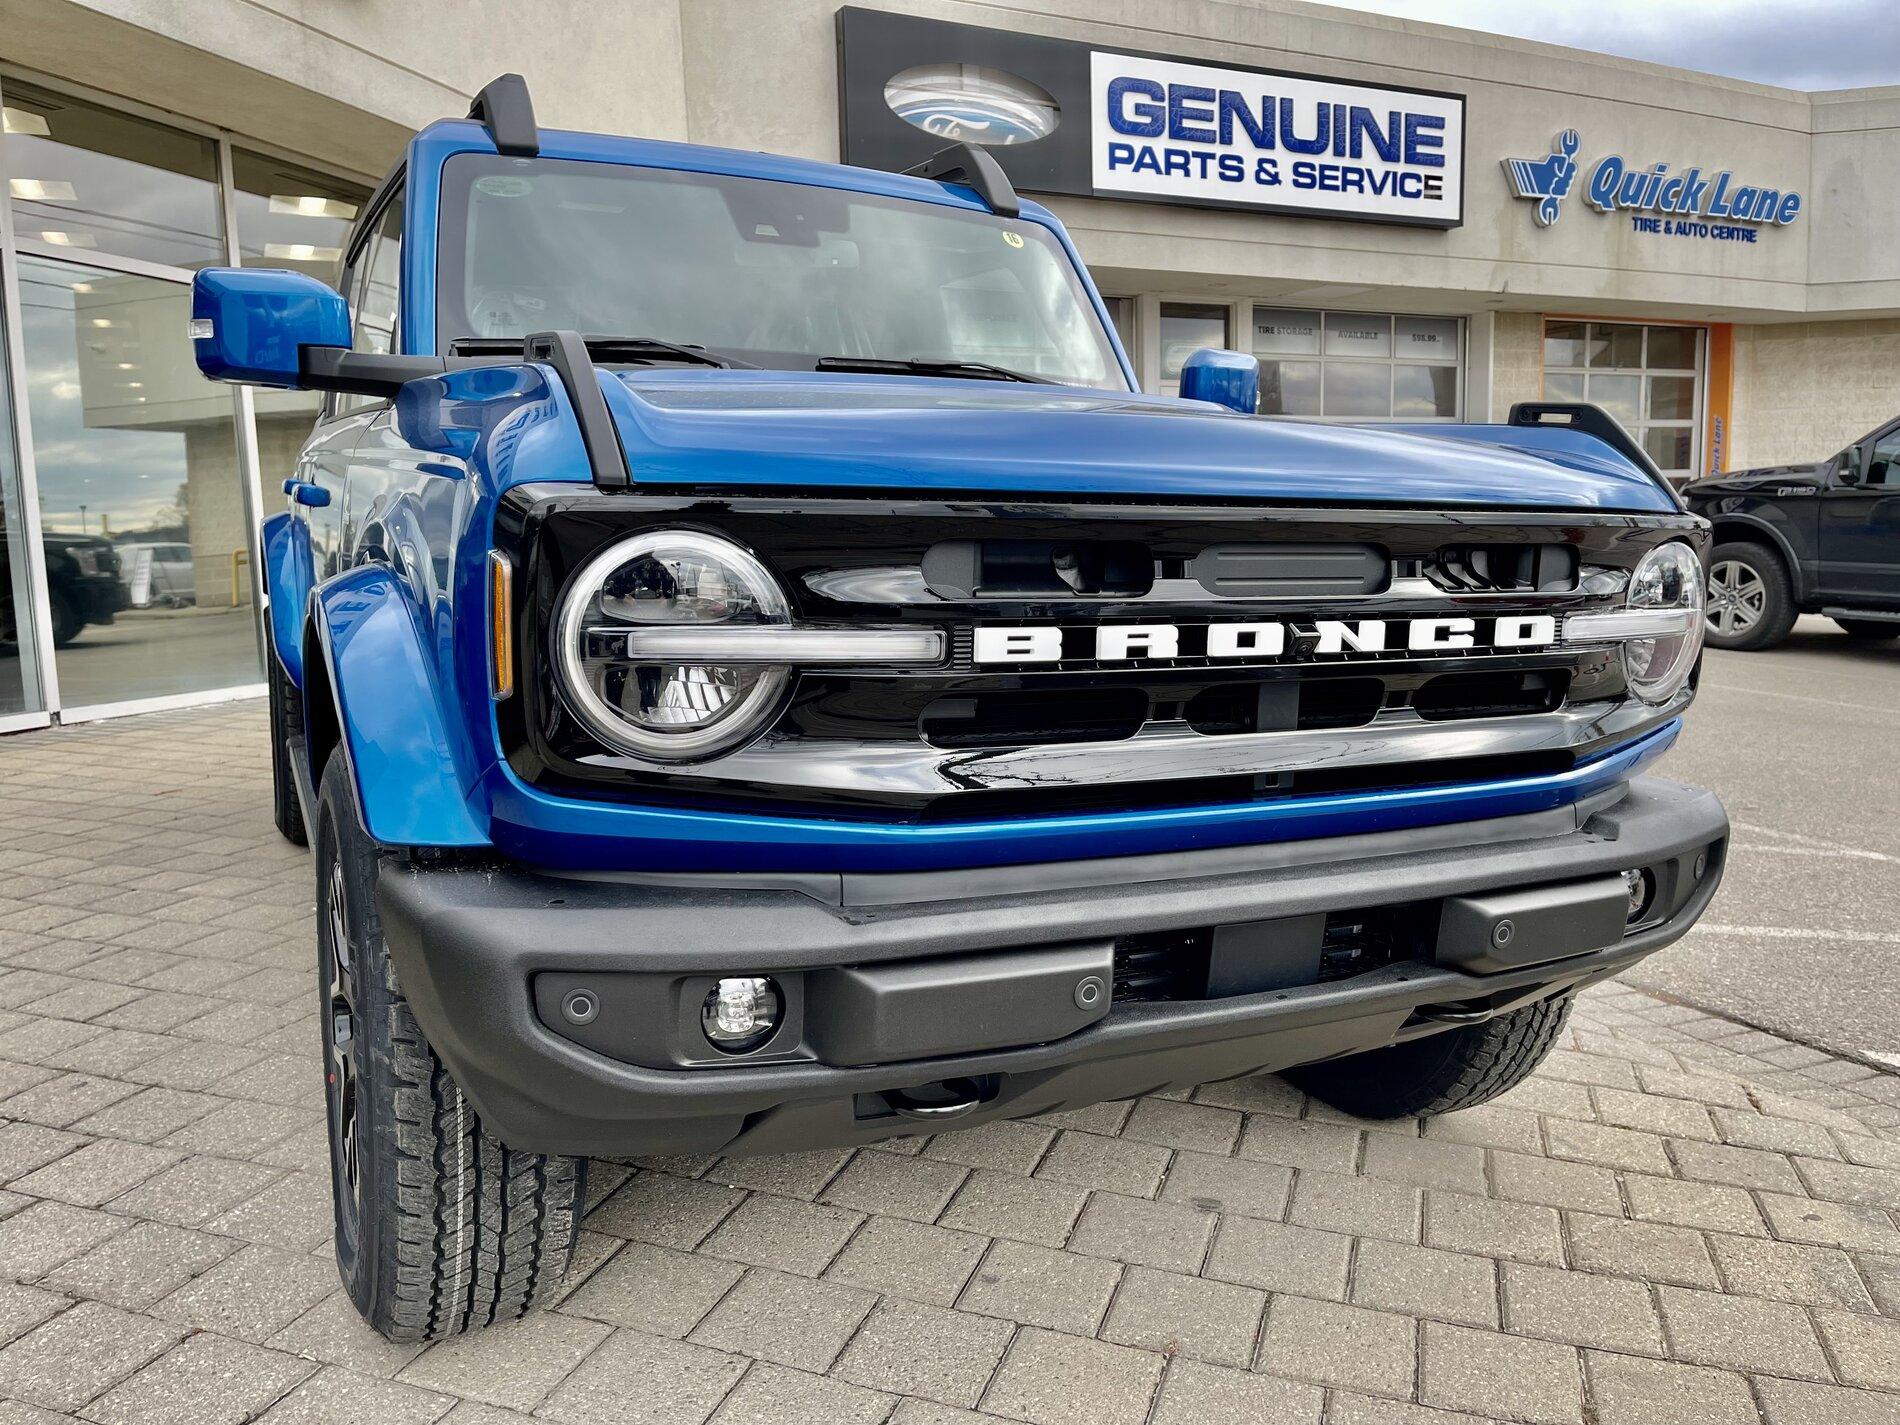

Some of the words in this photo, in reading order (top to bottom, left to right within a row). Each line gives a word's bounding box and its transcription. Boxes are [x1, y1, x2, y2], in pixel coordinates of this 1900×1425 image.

[1107, 76, 1446, 167] GENUINE
[1108, 142, 1245, 184] PARTS
[1255, 157, 1282, 186] &
[1292, 161, 1443, 200] SERVICE
[1589, 154, 1709, 214] Quick
[1707, 171, 1803, 226] Lane
[1632, 216, 1661, 234] TIRE
[1664, 220, 1673, 235] &
[1675, 221, 1709, 239] AUTO
[1710, 227, 1758, 243] CENTRE
[1258, 325, 1275, 335] TIRE
[1276, 327, 1313, 337] STORAGE
[1338, 329, 1379, 340] AVAILABLE
[1713, 416, 1721, 445] Lane
[974, 615, 1556, 664] BRONCO
